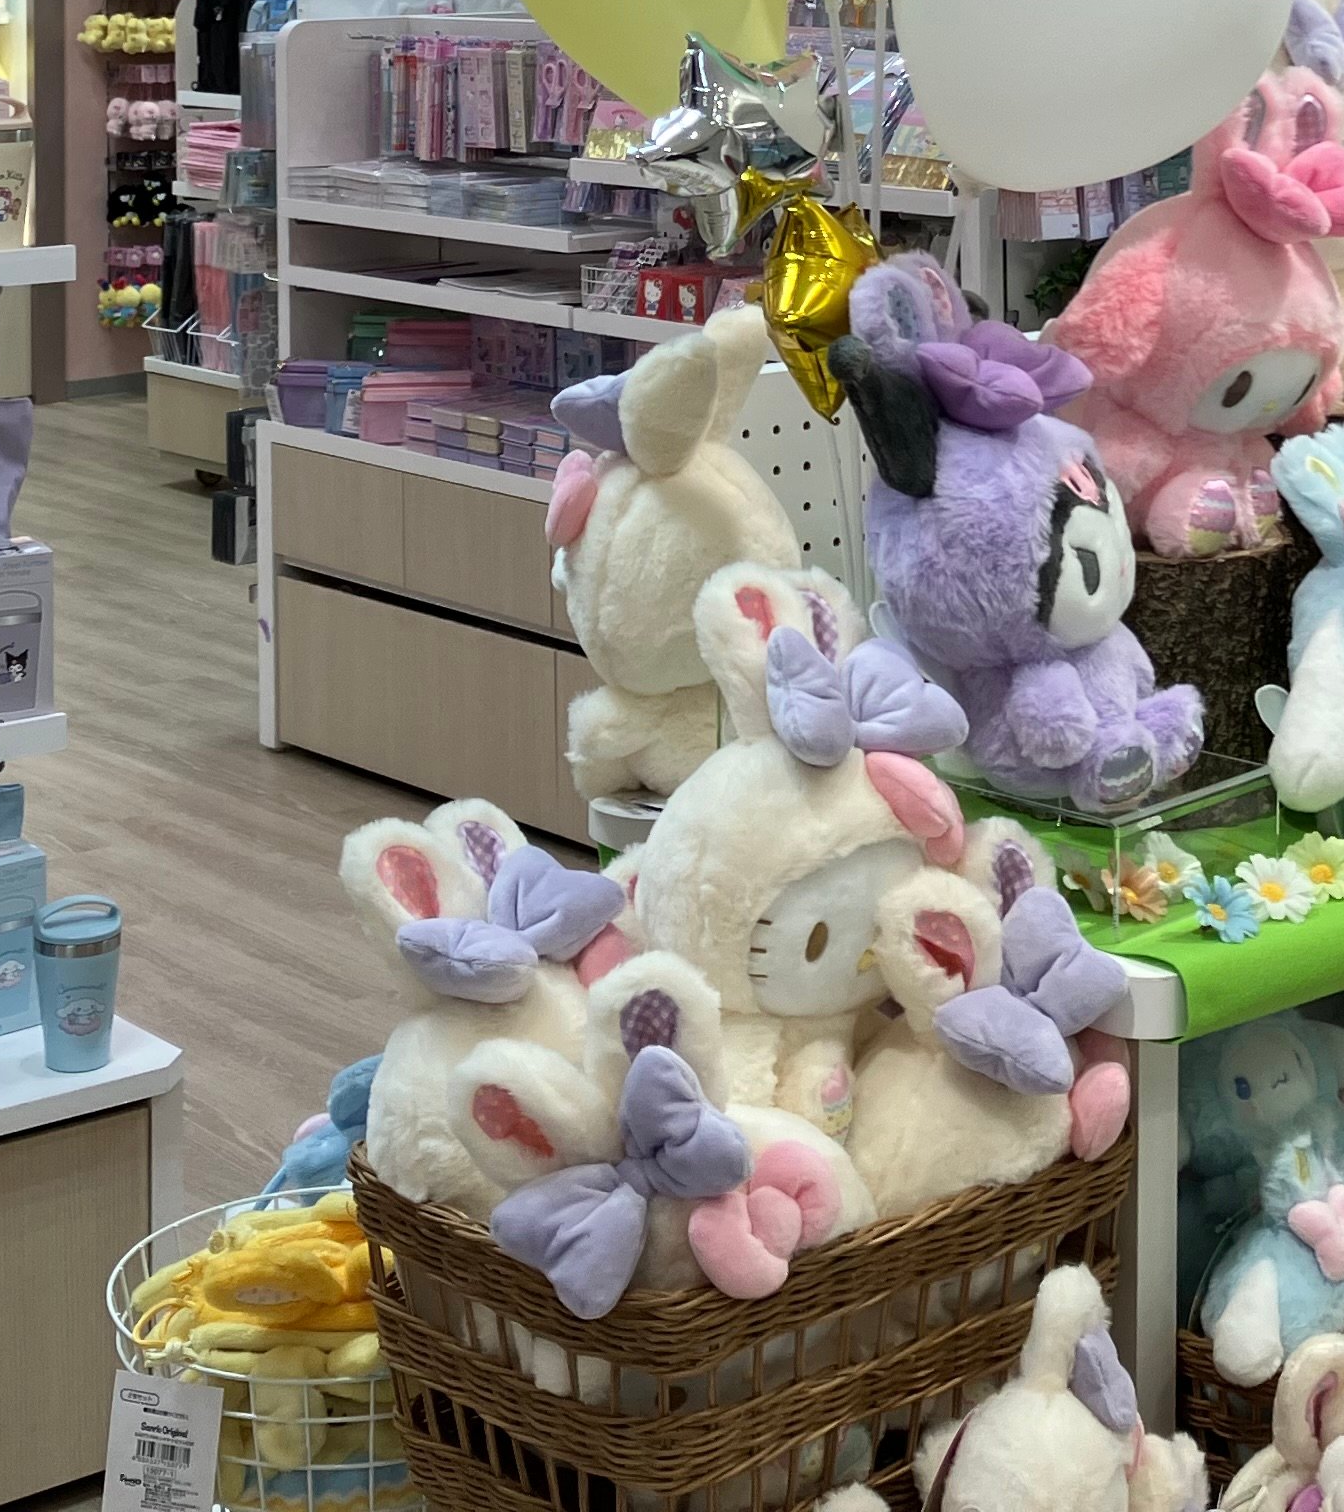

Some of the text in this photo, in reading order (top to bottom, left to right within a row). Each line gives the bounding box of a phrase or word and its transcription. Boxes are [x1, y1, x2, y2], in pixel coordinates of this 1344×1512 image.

[5, 169, 26, 187] Kitty
[141, 1421, 189, 1438] Sanrio Original
